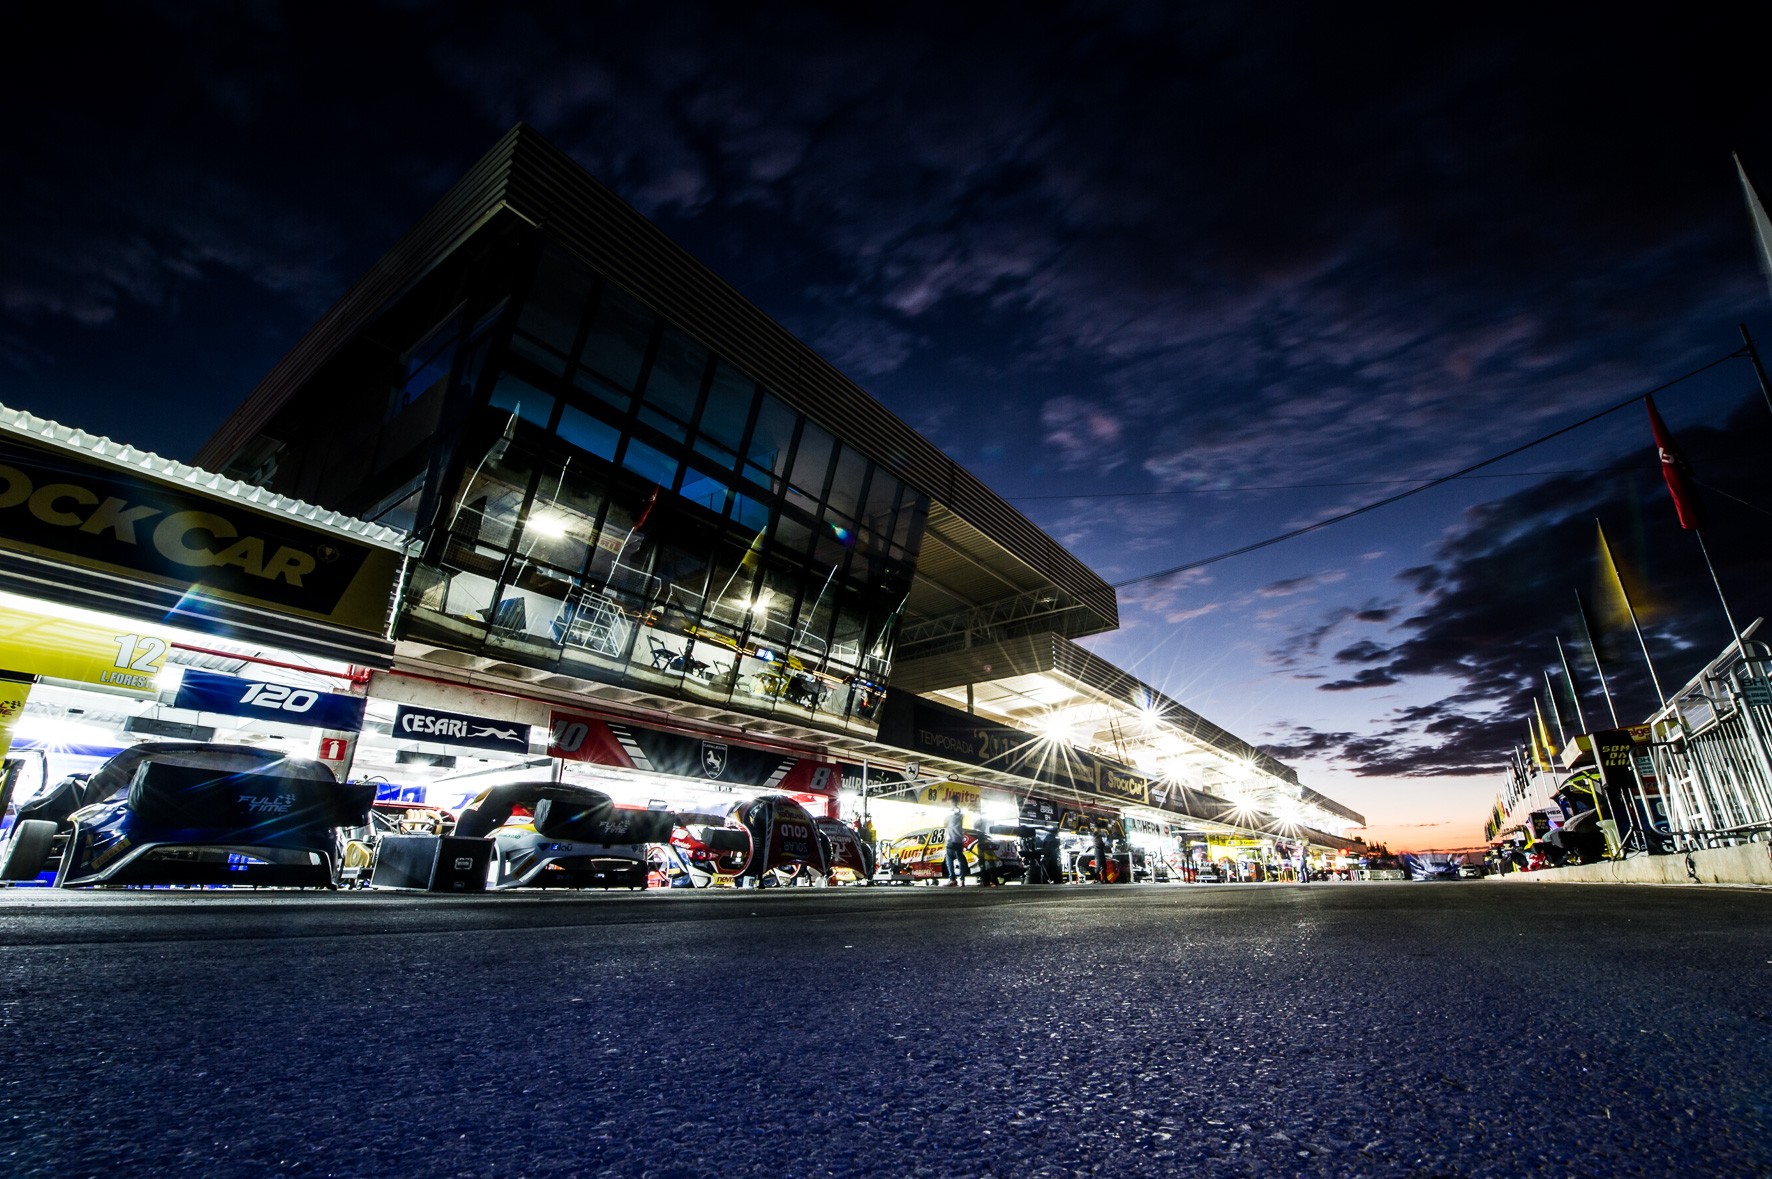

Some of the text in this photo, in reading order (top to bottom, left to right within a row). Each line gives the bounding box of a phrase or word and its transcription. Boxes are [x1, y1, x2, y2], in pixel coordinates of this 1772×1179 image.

[114, 633, 167, 673] 12
[239, 683, 319, 713] 120
[553, 719, 589, 752] 10
[919, 729, 974, 754] TEMPORADA
[810, 767, 832, 790] 8
[237, 795, 282, 804] FULL
[928, 788, 938, 801] 83
[248, 804, 292, 813] TIME
[781, 824, 808, 839] GOLD
[931, 829, 945, 844] 83
